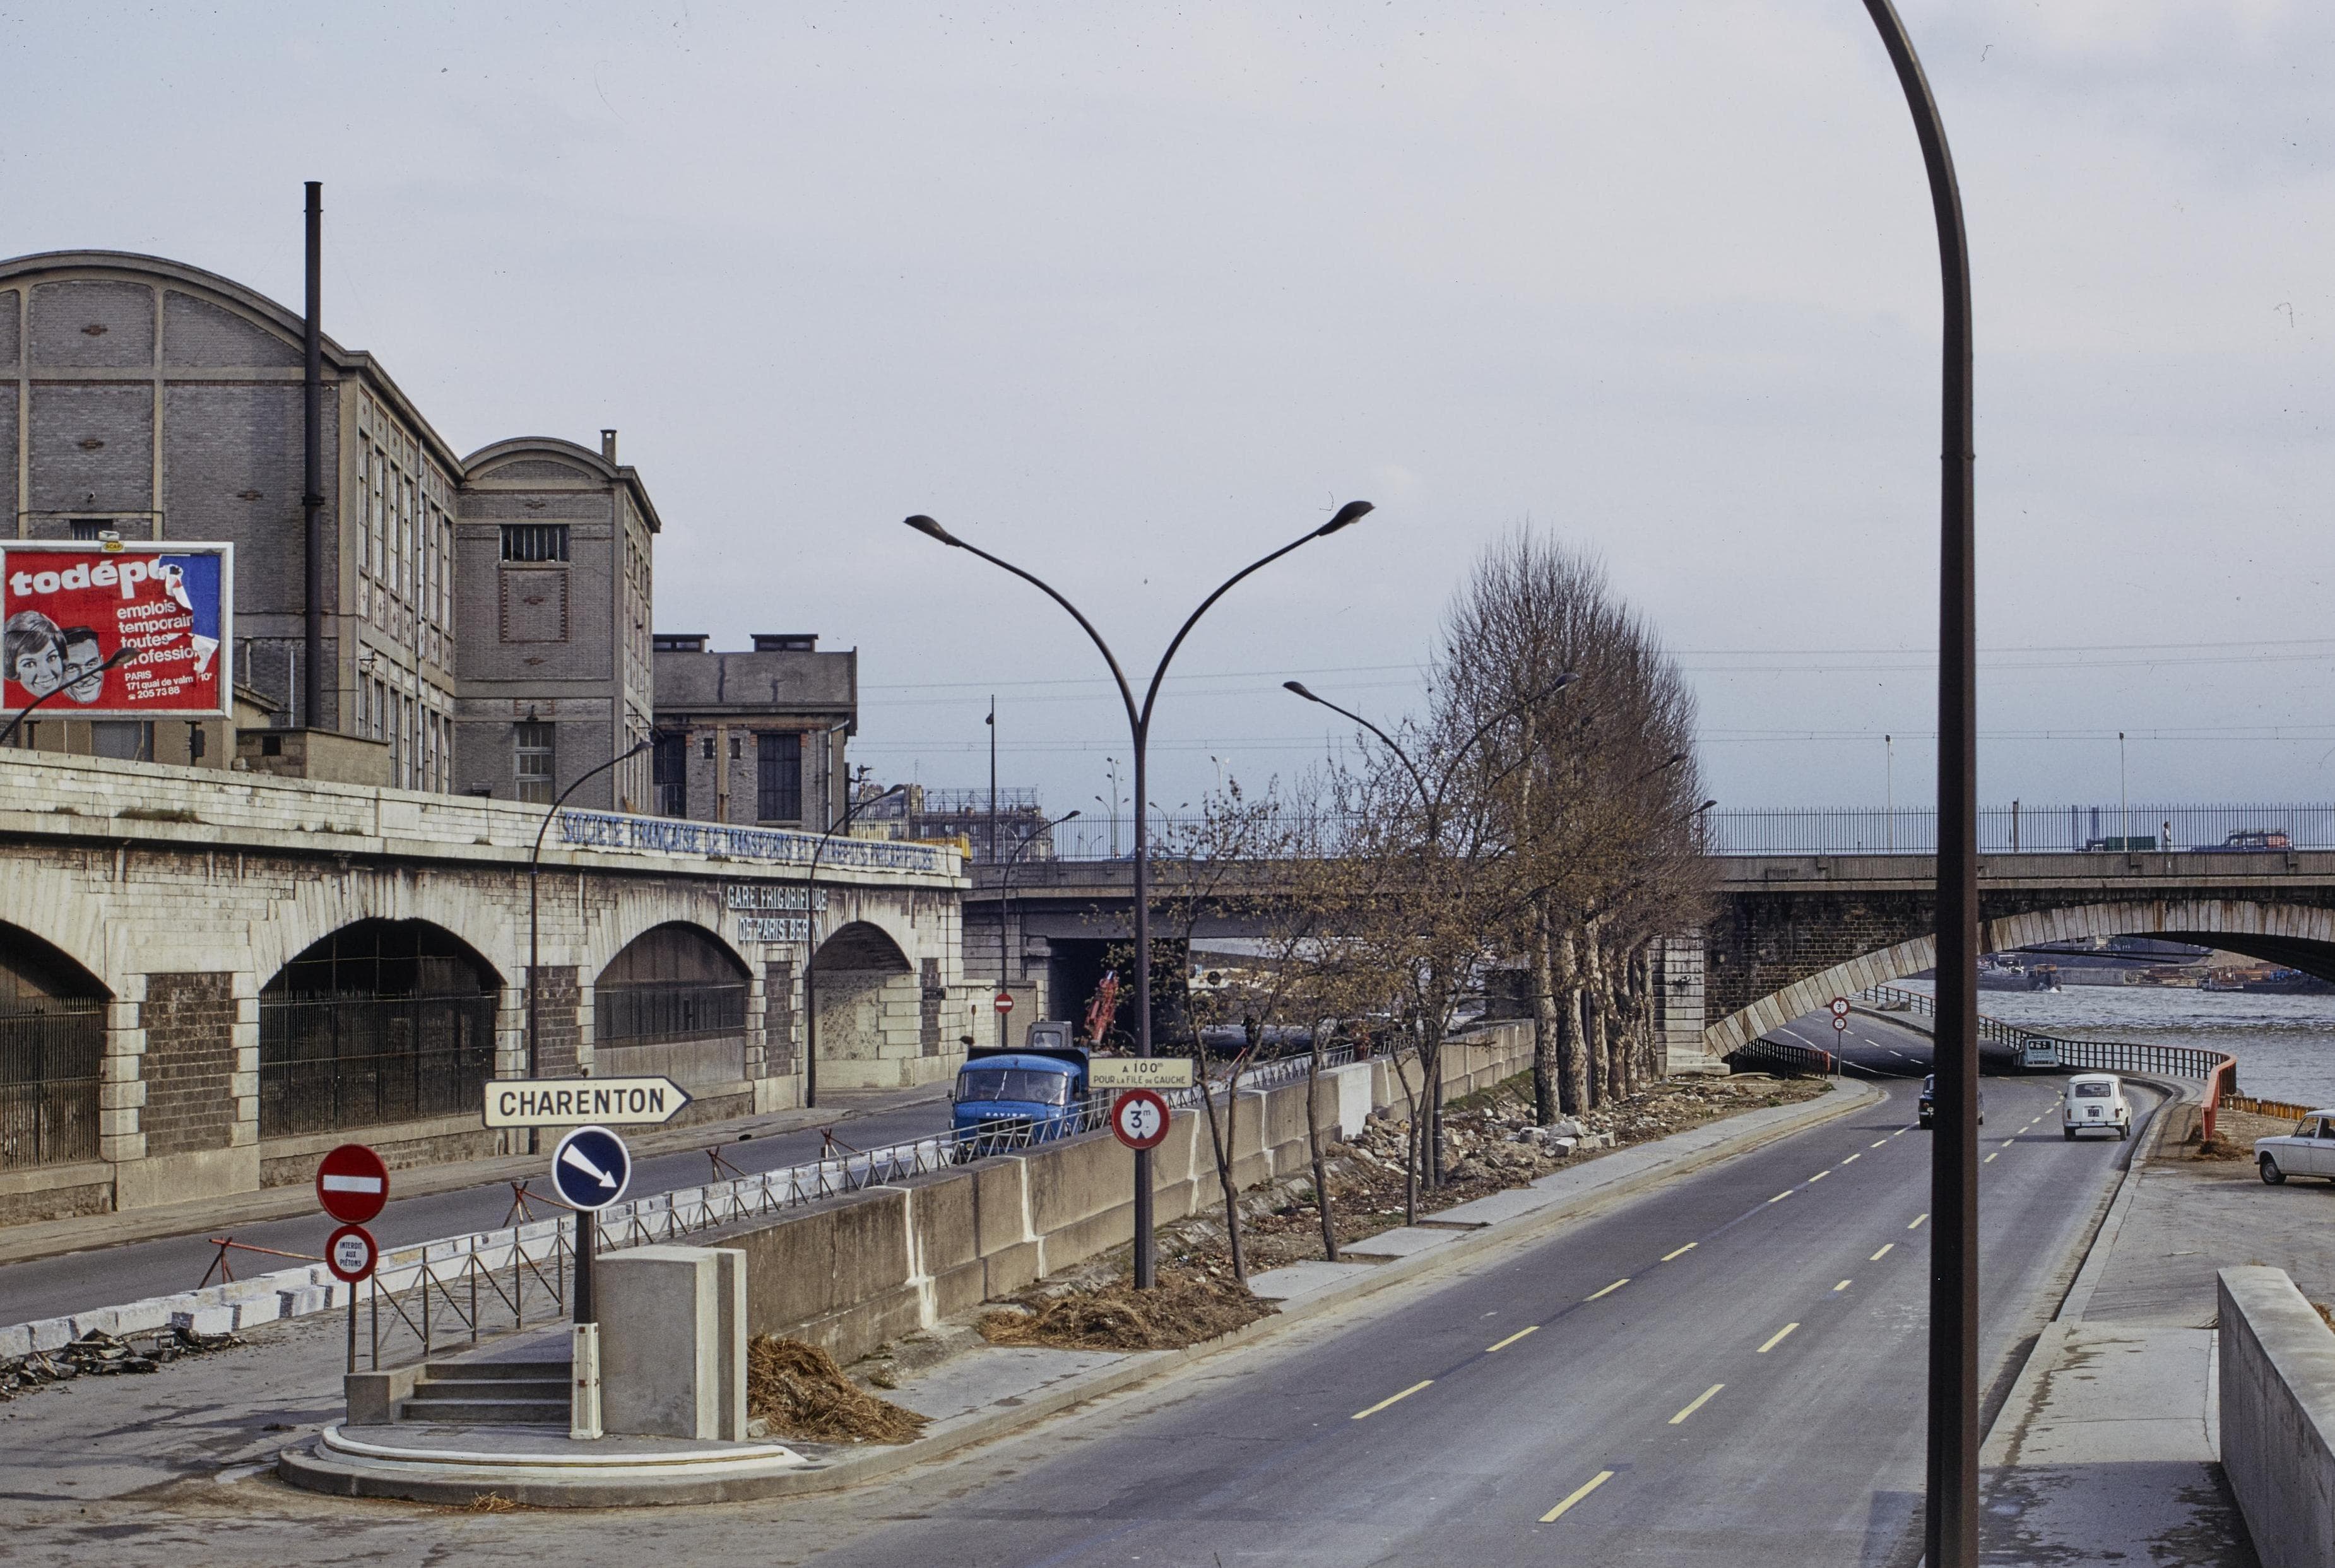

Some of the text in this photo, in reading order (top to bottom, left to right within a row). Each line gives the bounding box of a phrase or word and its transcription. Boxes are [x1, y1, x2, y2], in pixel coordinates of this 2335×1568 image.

[117, 599, 176, 619] emplois
[118, 613, 194, 633] temporair
[121, 633, 169, 649] toutes
[125, 671, 151, 681] PARIS
[126, 681, 139, 690] 171
[141, 679, 160, 690] quai
[138, 686, 180, 699] 205 73 88
[728, 885, 827, 910] GARE FRIGORIFIUE
[738, 918, 820, 941] DE PARIS BERY
[1094, 1076, 1115, 1084] POUR
[1126, 1076, 1142, 1084] FILE
[1154, 1076, 1186, 1084] GAUCHE
[499, 1087, 665, 1116] CHARENTON
[340, 1258, 362, 1267] PIÉTONS
